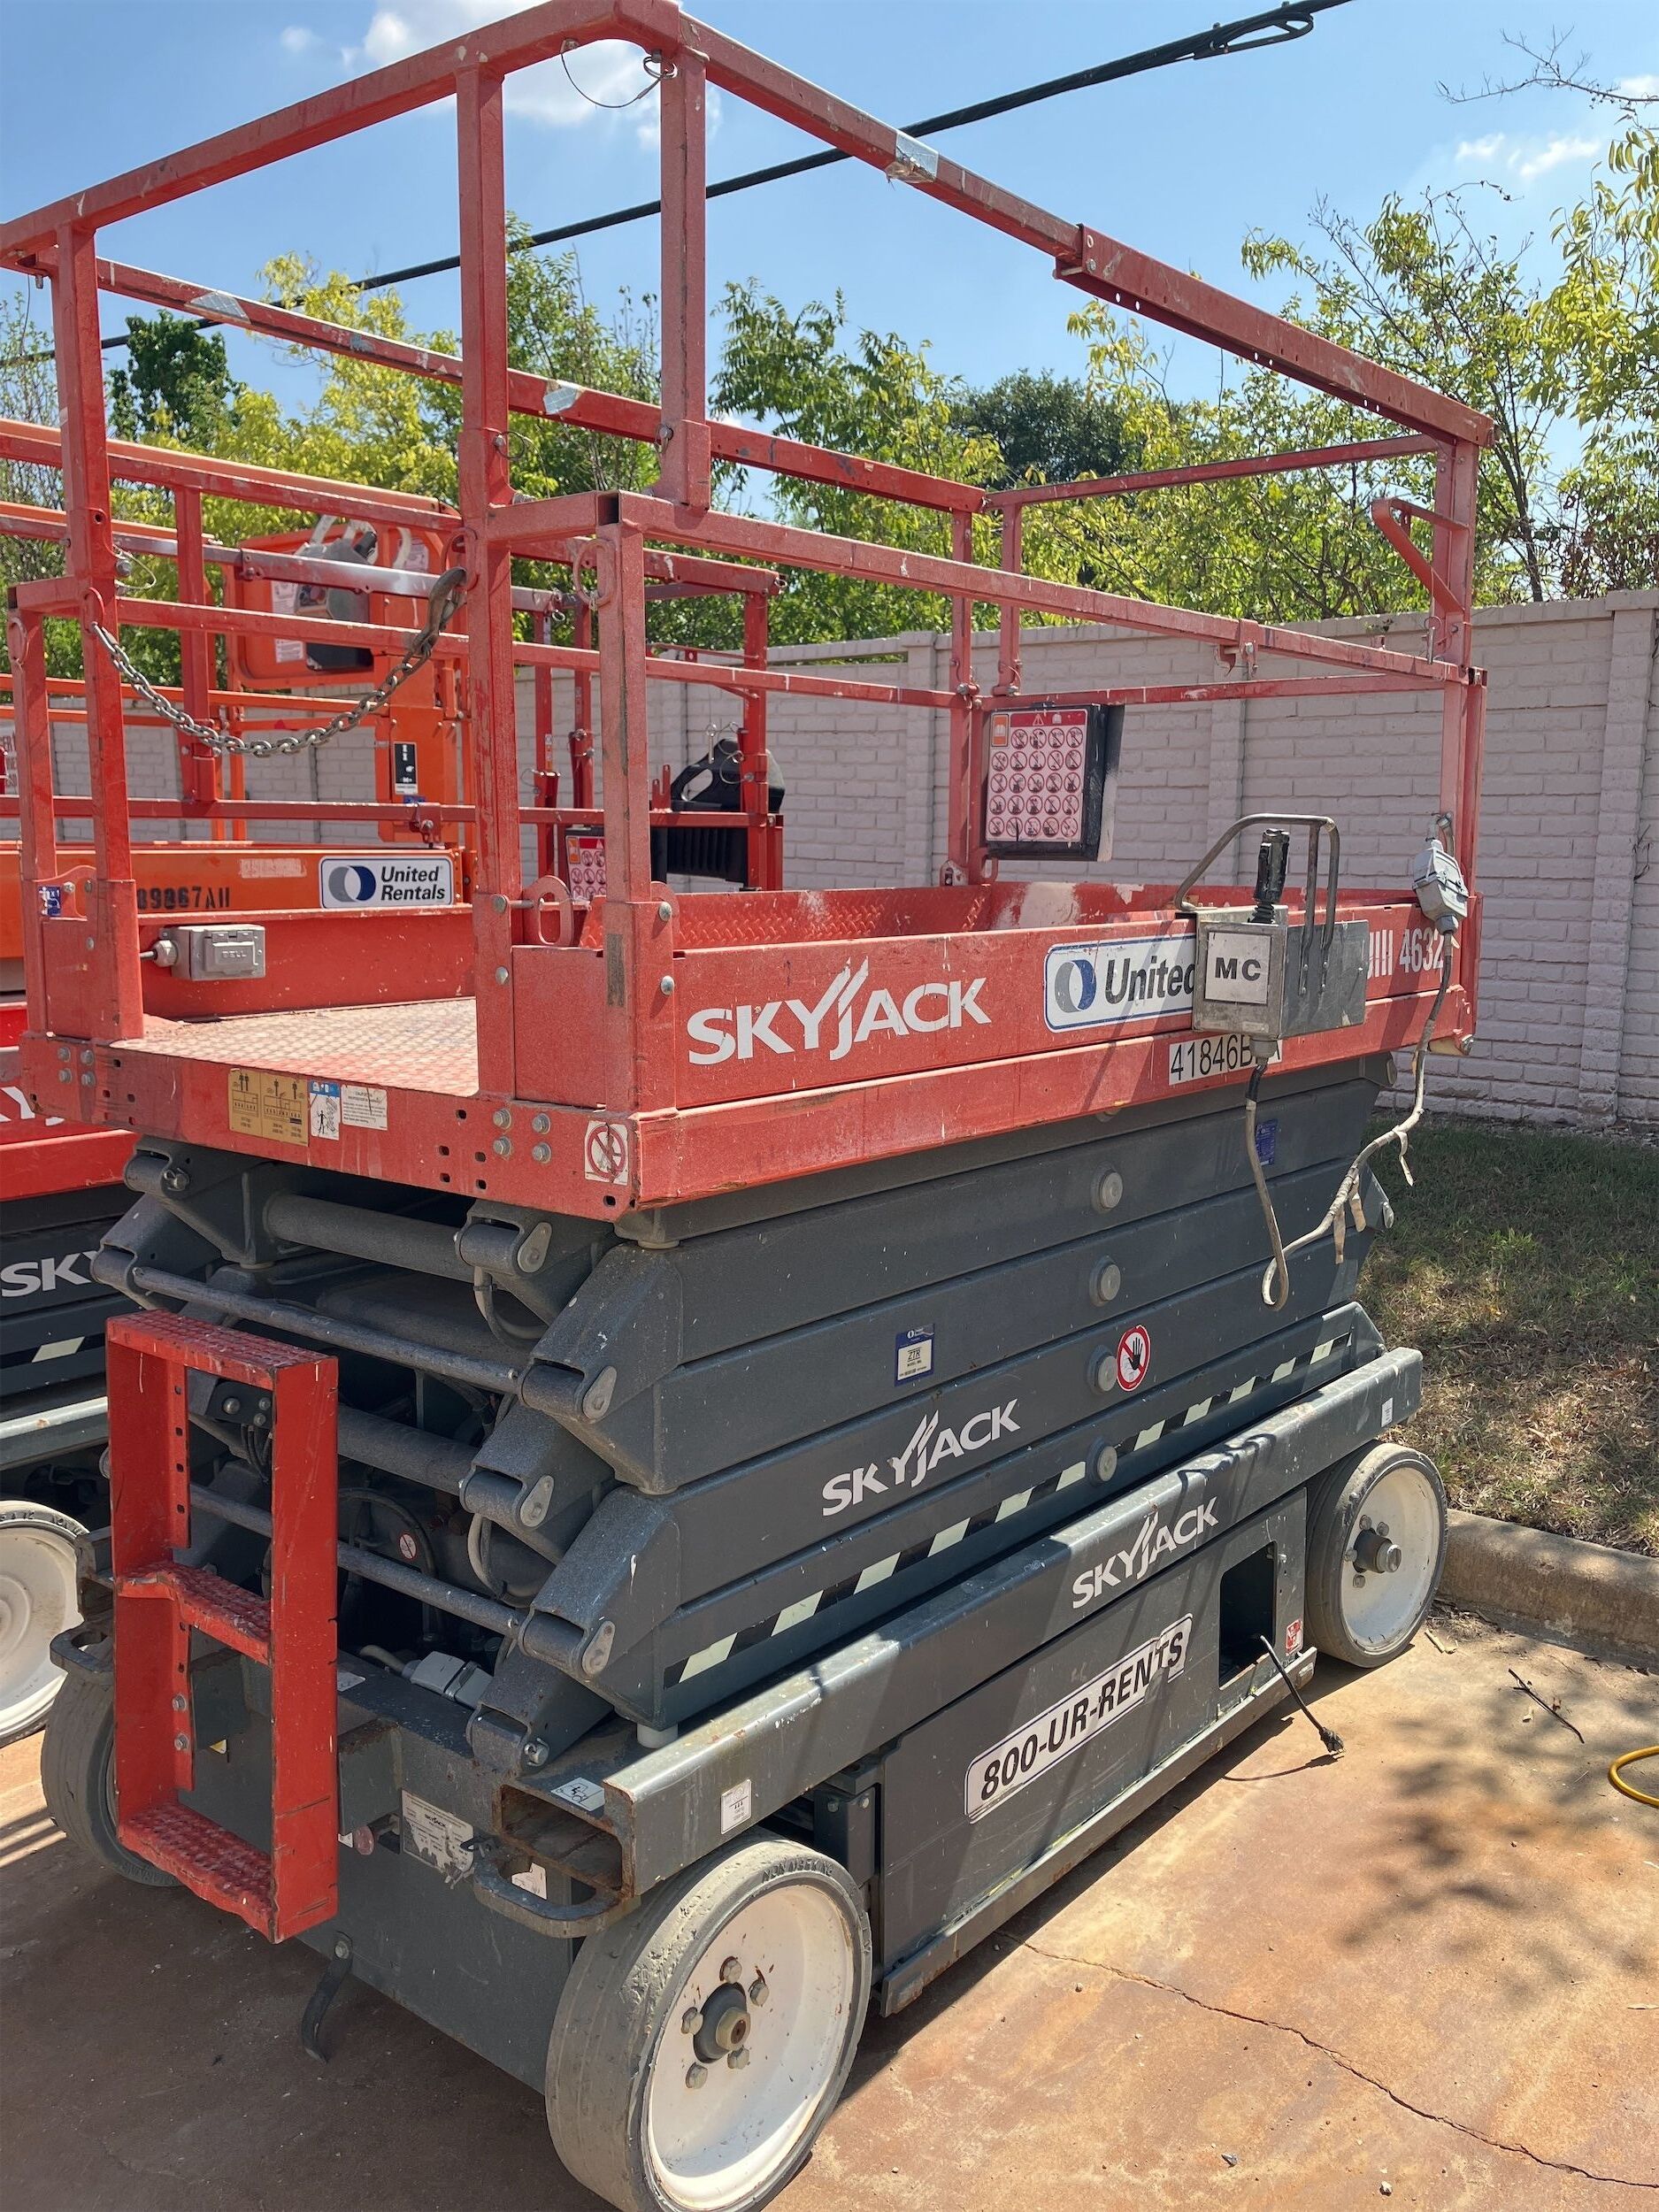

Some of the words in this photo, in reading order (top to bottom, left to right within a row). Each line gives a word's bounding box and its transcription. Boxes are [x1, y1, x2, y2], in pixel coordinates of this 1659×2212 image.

[380, 884, 445, 901] Rentals
[381, 865, 440, 882] United
[1215, 956, 1262, 981] MC
[1399, 927, 1445, 973] 4632
[687, 956, 992, 1066] SKYJACK
[0, 1250, 97, 1298] SK
[822, 1398, 1021, 1517] SKYJACK
[1072, 1496, 1219, 1609] SKYJACK
[980, 1632, 1184, 1801] 800-UR-RENTS
